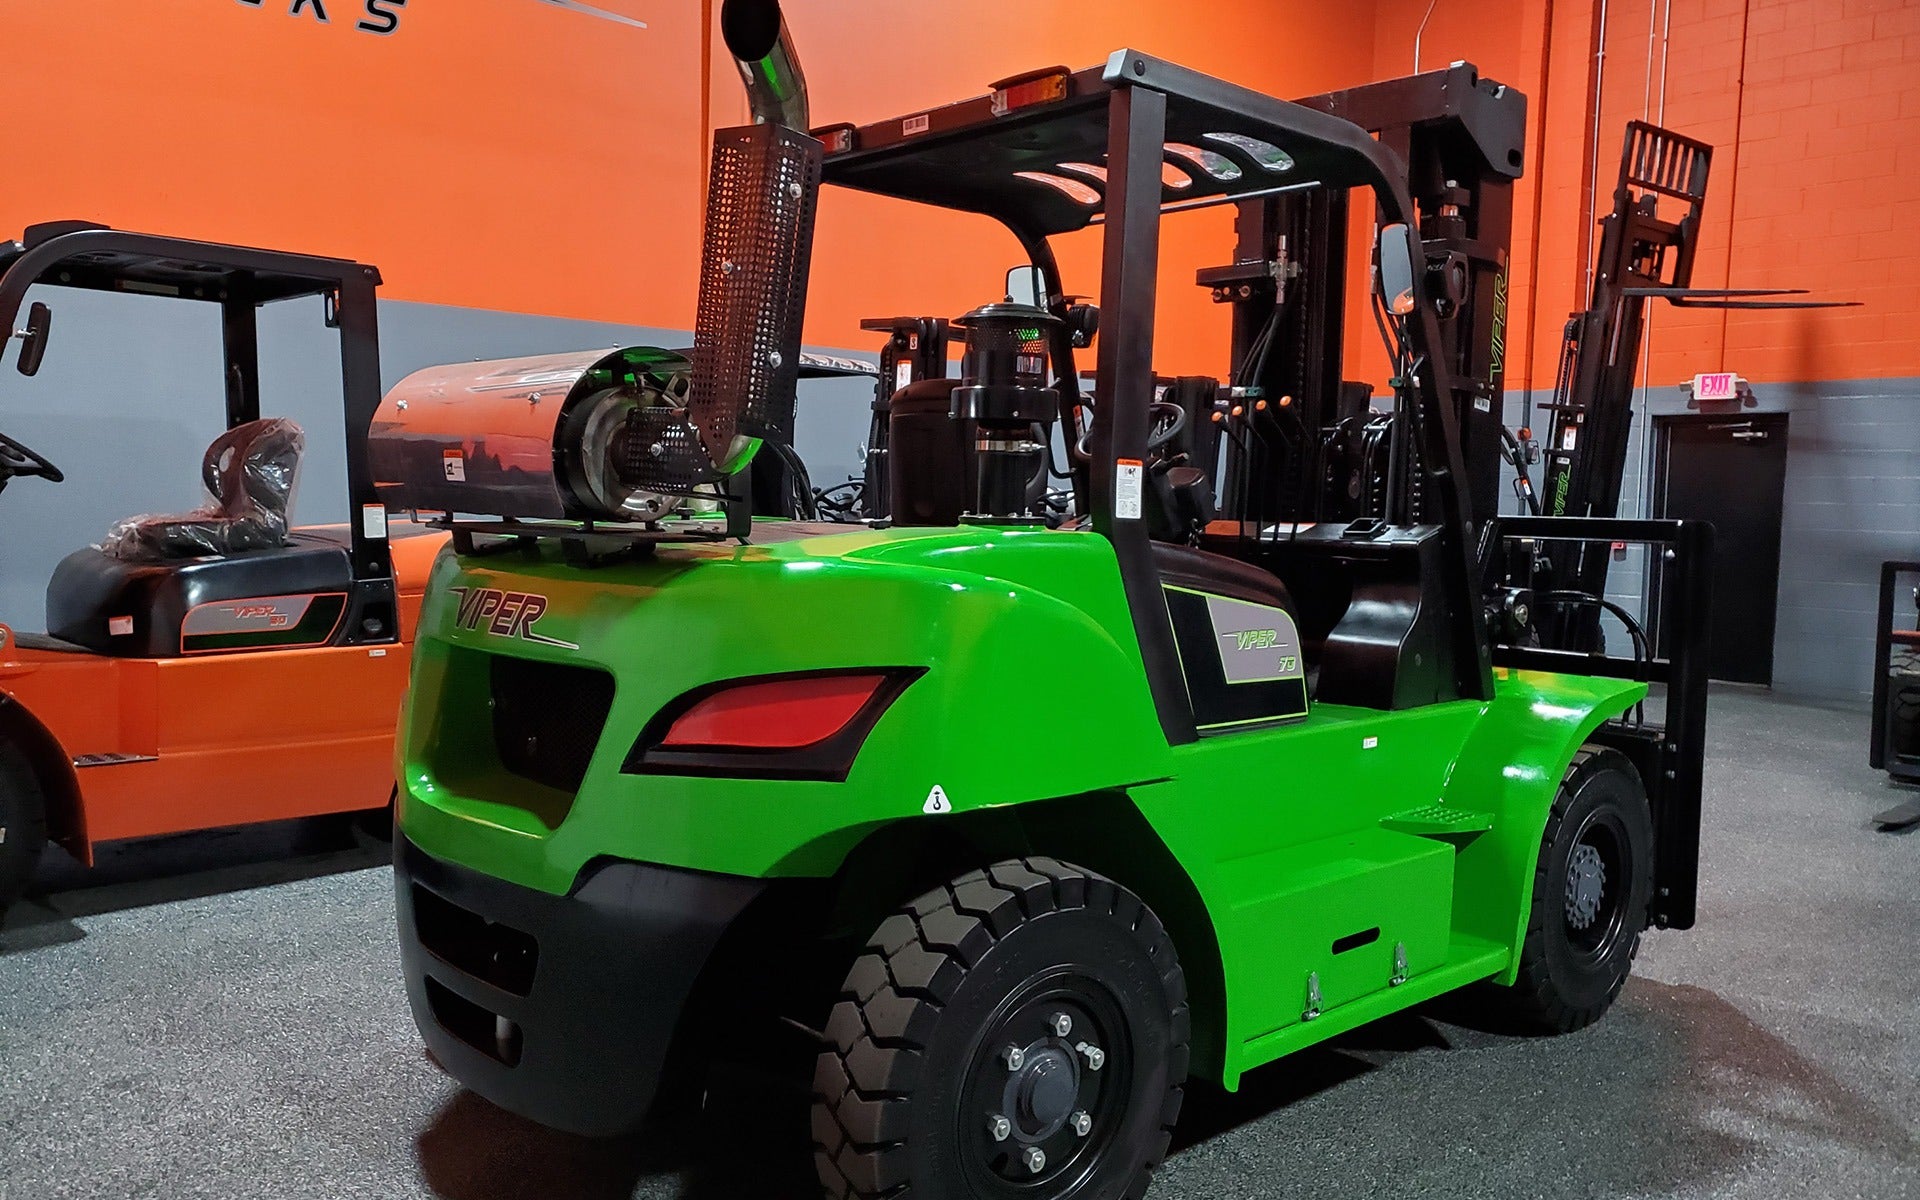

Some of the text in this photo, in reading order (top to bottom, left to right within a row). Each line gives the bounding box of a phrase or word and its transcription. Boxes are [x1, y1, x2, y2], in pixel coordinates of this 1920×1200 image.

[1490, 256, 1509, 383] VIPER
[1701, 374, 1731, 396] EXIT
[1553, 464, 1571, 516] VIPER
[219, 605, 288, 618] VIPER
[446, 586, 580, 650] VIPER
[1222, 629, 1289, 650] VIPER
[1279, 655, 1297, 673] 70
